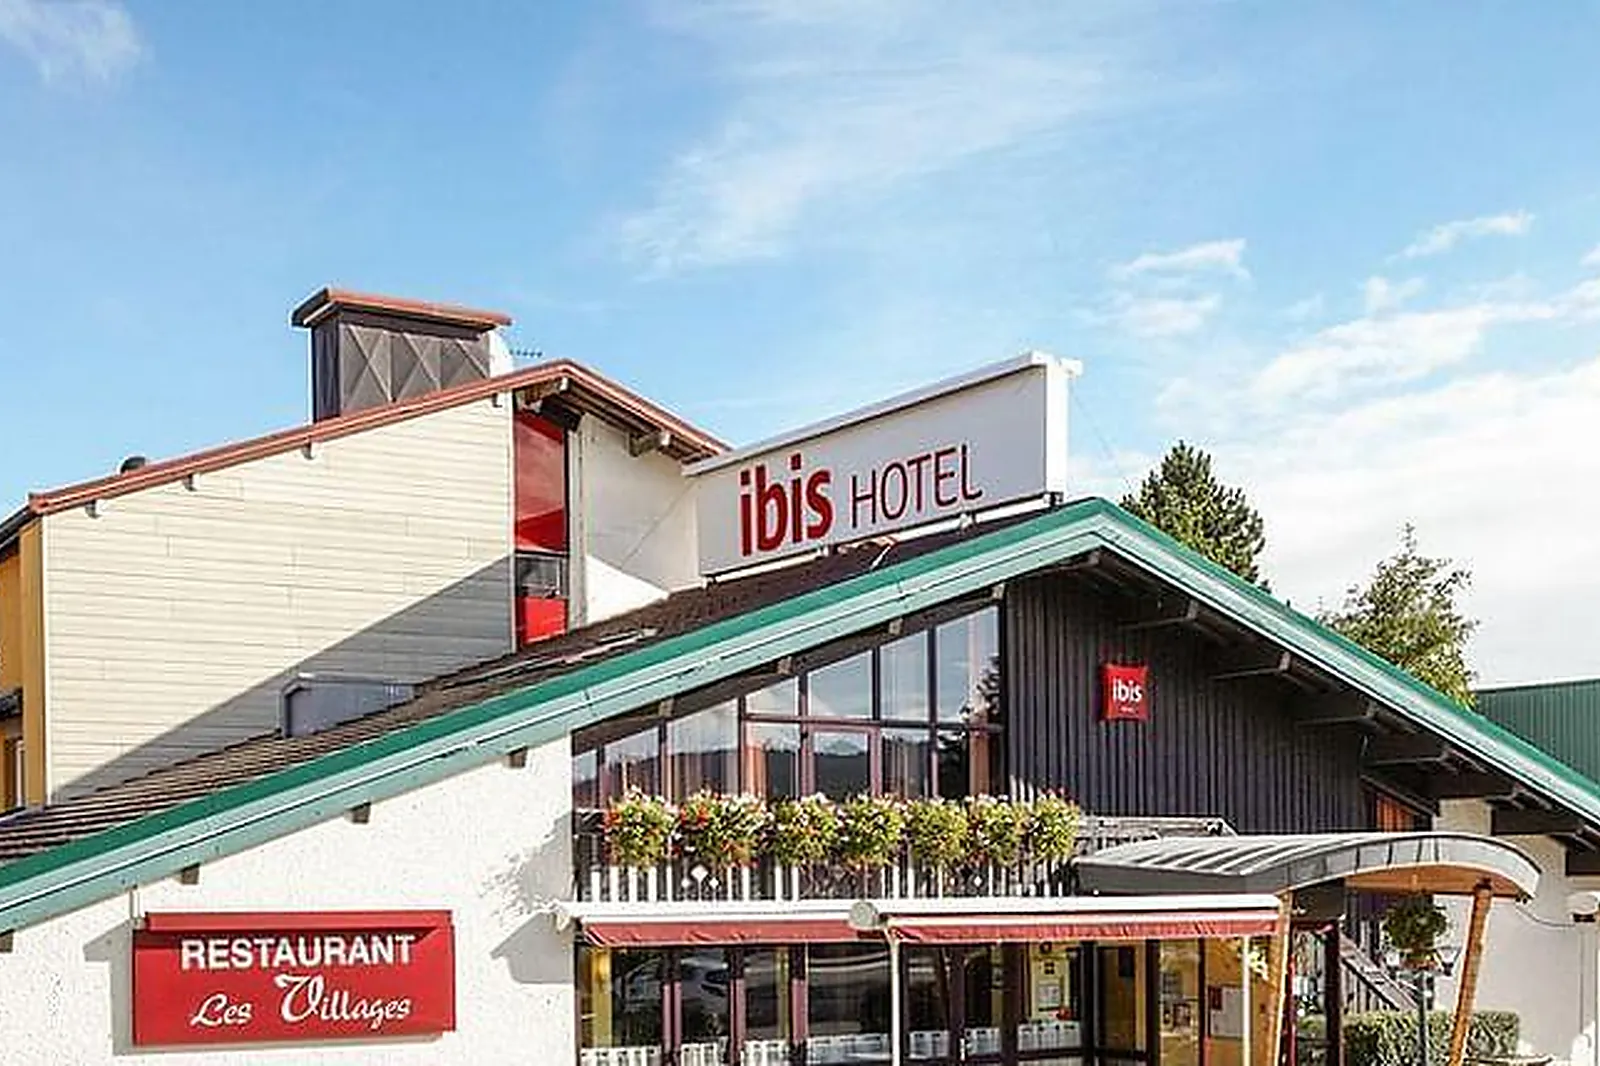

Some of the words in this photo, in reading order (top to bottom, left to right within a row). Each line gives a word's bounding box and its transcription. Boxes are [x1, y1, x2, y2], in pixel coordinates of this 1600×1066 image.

[740, 452, 833, 556] ibis
[851, 444, 983, 528] HOTEL
[1112, 677, 1143, 702] ibis
[180, 934, 414, 970] RESTAURANT
[190, 993, 252, 1027] Les
[273, 973, 411, 1029] Villages
